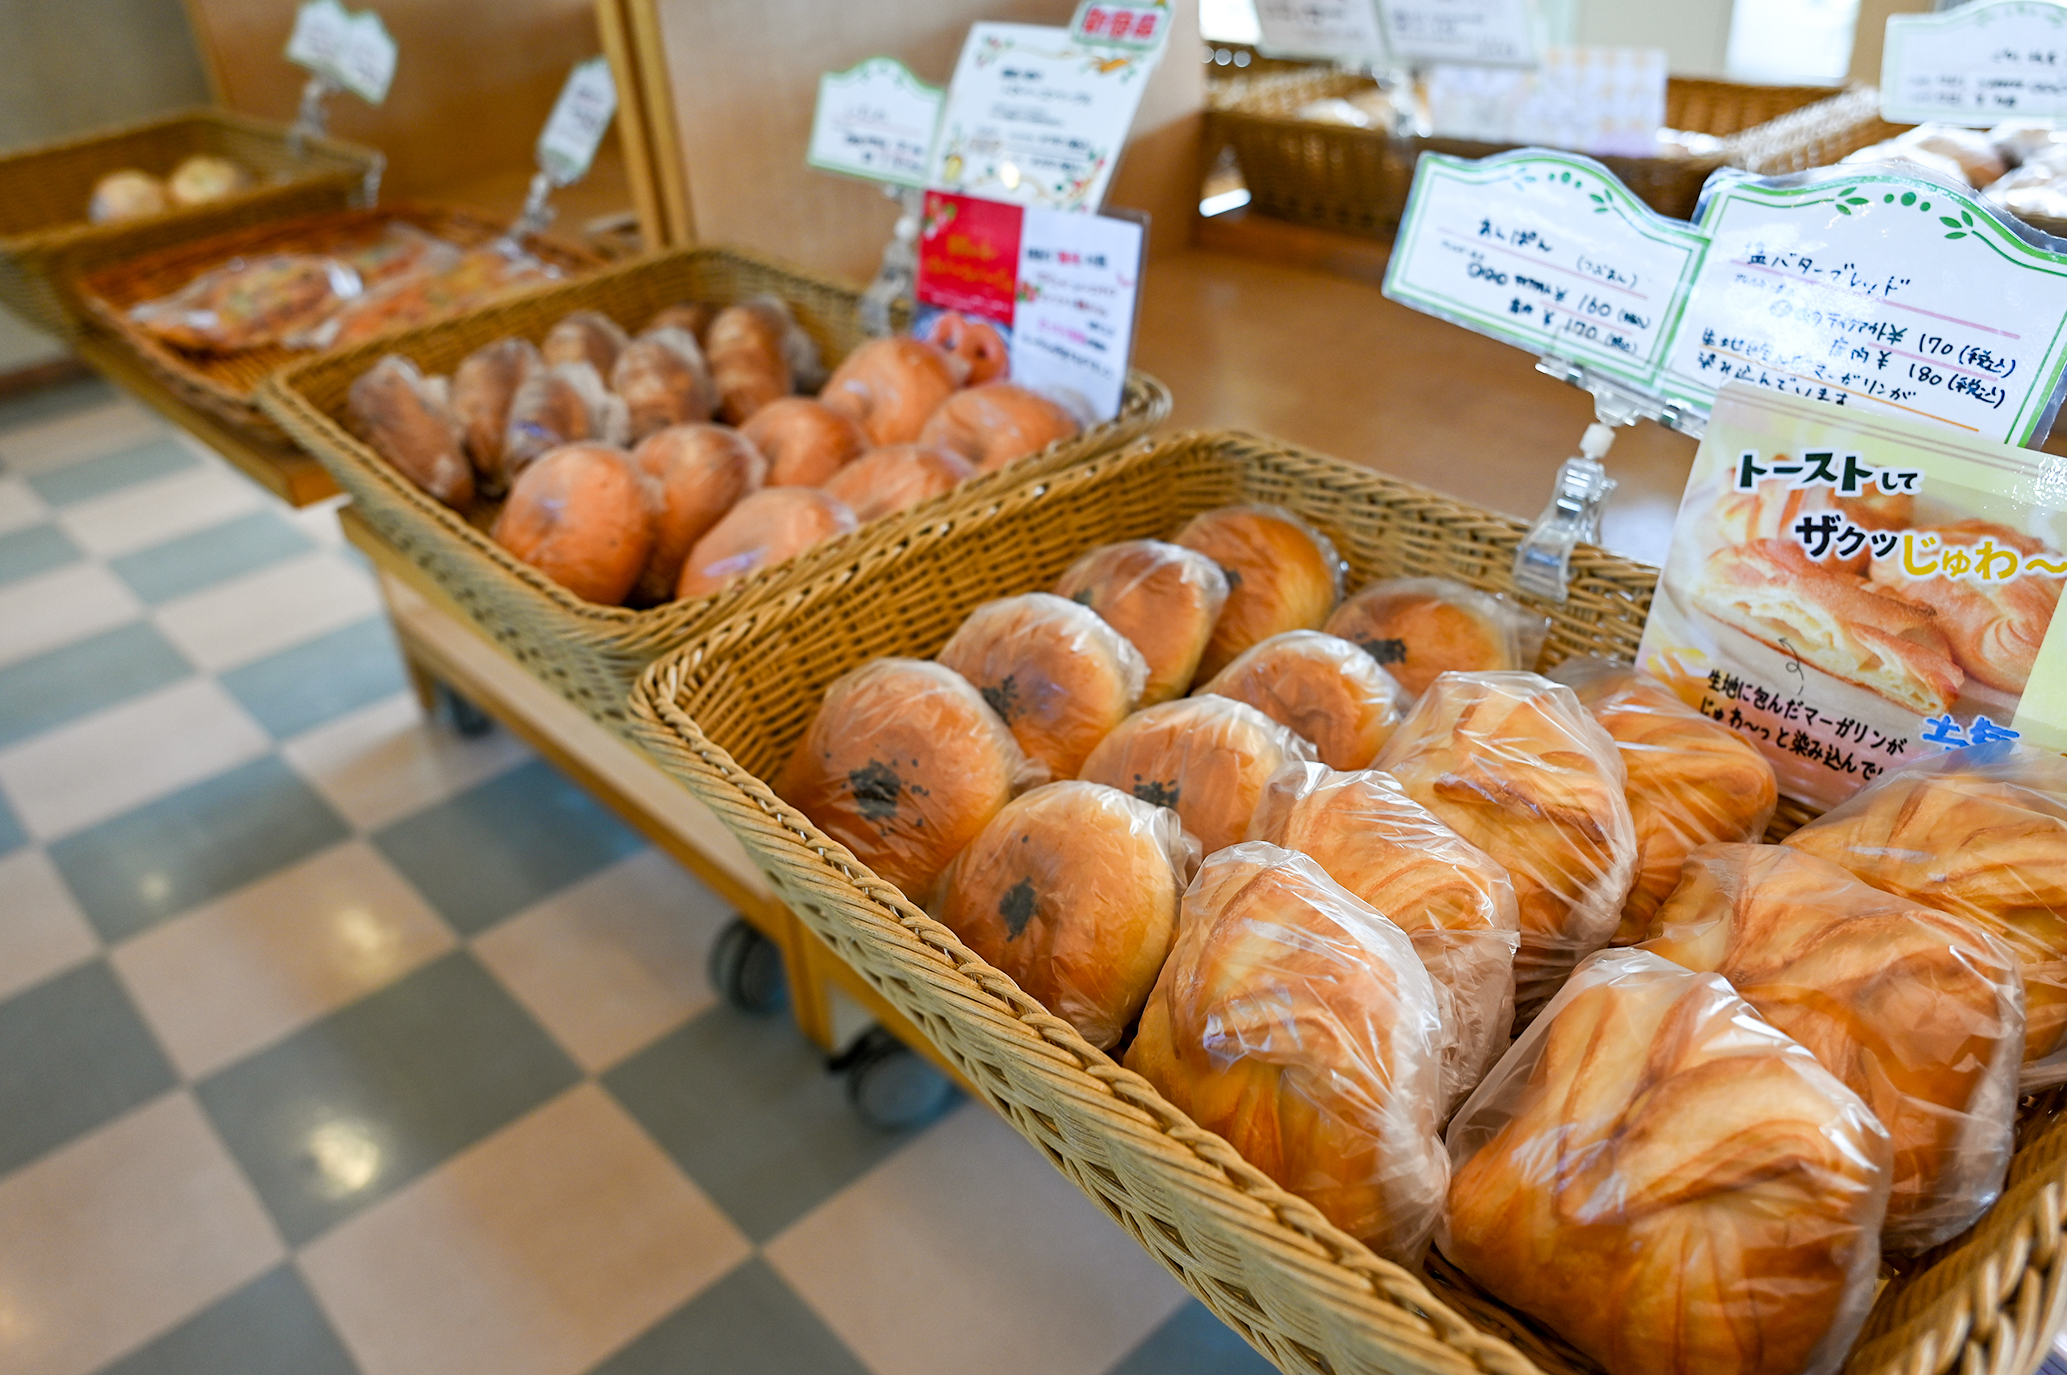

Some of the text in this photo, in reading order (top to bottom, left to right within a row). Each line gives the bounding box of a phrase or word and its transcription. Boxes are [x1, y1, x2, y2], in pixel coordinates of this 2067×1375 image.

[1478, 218, 1553, 253] あんぱん
[1745, 242, 1911, 296] 塩バターブレッド
[1578, 294, 1611, 316] 160
[1698, 352, 1848, 406] 染み込んでいます
[1919, 333, 1954, 355] 170
[1958, 345, 2017, 379] (税込)
[1909, 363, 1943, 386] 180
[1947, 373, 2006, 410] (税込)
[1739, 452, 1919, 492] トーストして
[1708, 669, 1908, 756] 生地に包んだマーガリンが
